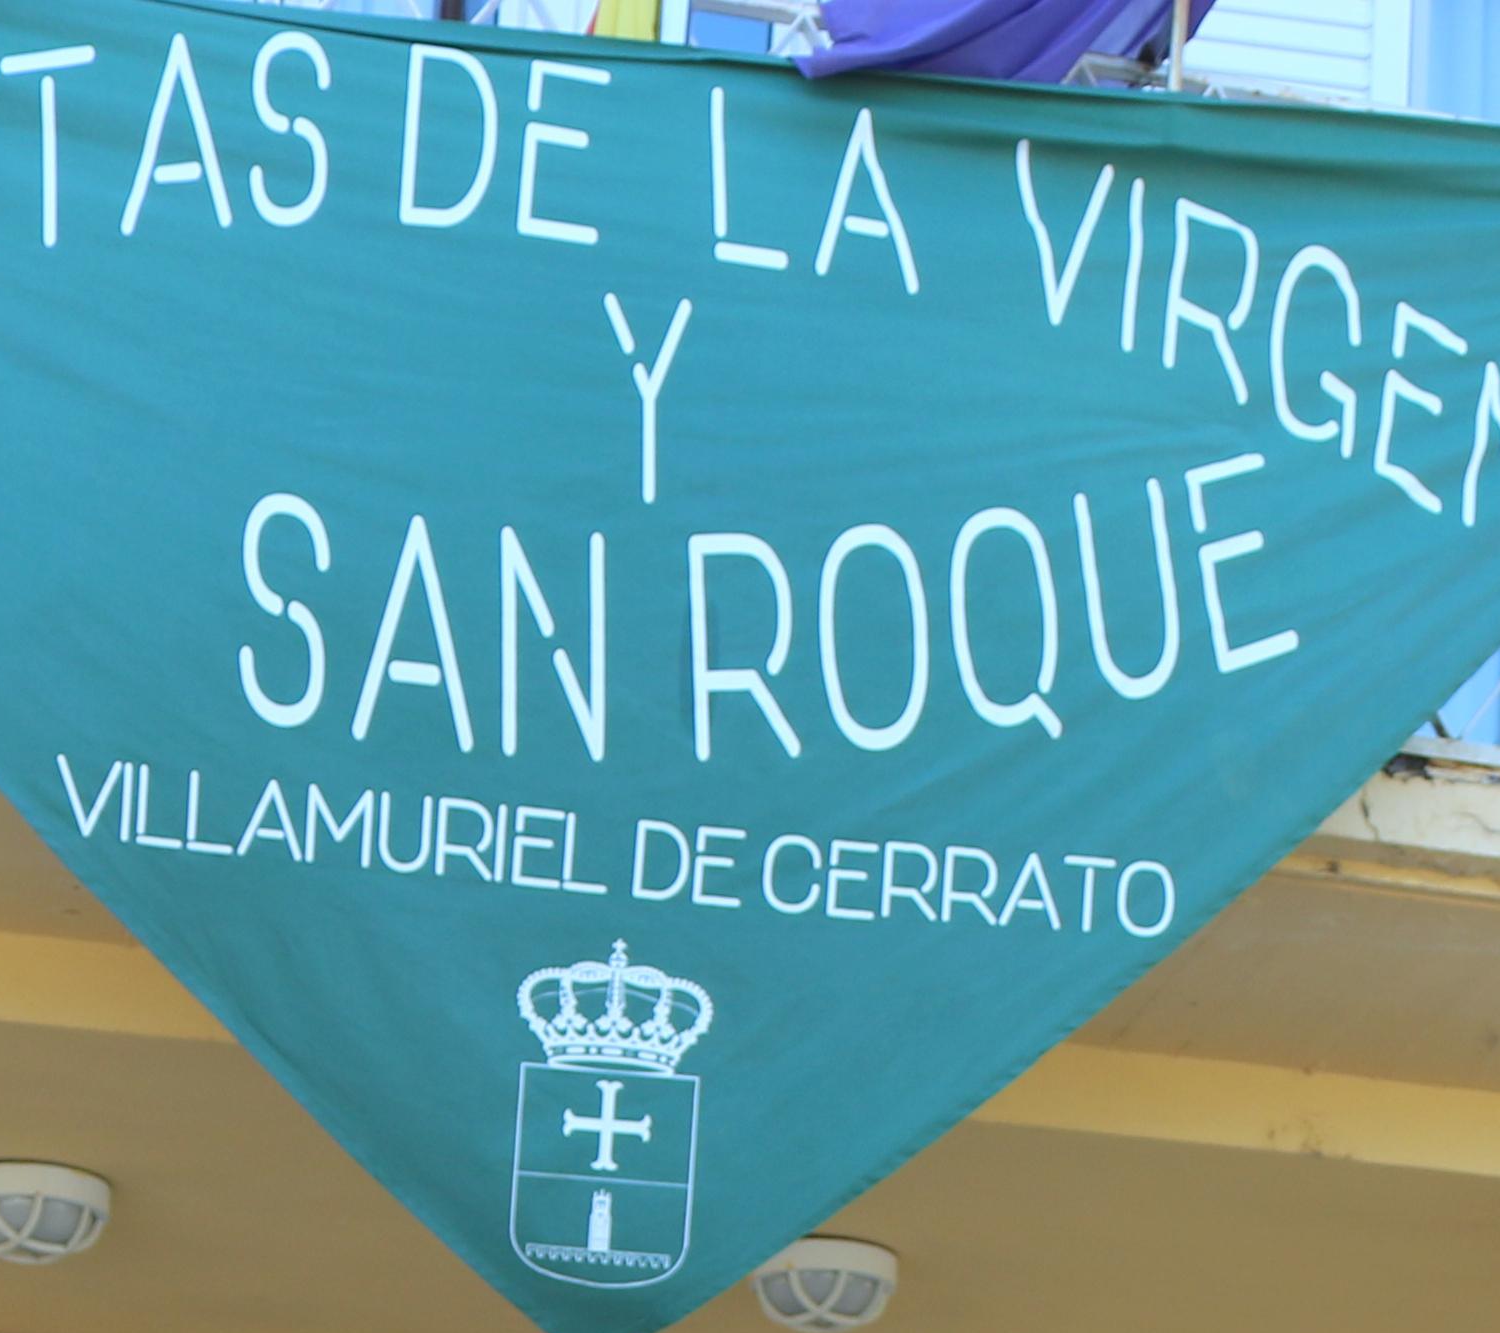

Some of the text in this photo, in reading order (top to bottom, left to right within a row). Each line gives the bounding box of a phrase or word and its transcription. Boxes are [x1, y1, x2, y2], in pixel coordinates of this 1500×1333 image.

[398, 42, 613, 246] DE
[709, 85, 921, 296] LA
[604, 291, 694, 504] Y
[238, 452, 1301, 762] SAN ROQUE
[56, 753, 1176, 938] VILLAMURIEL DE CERRATO
